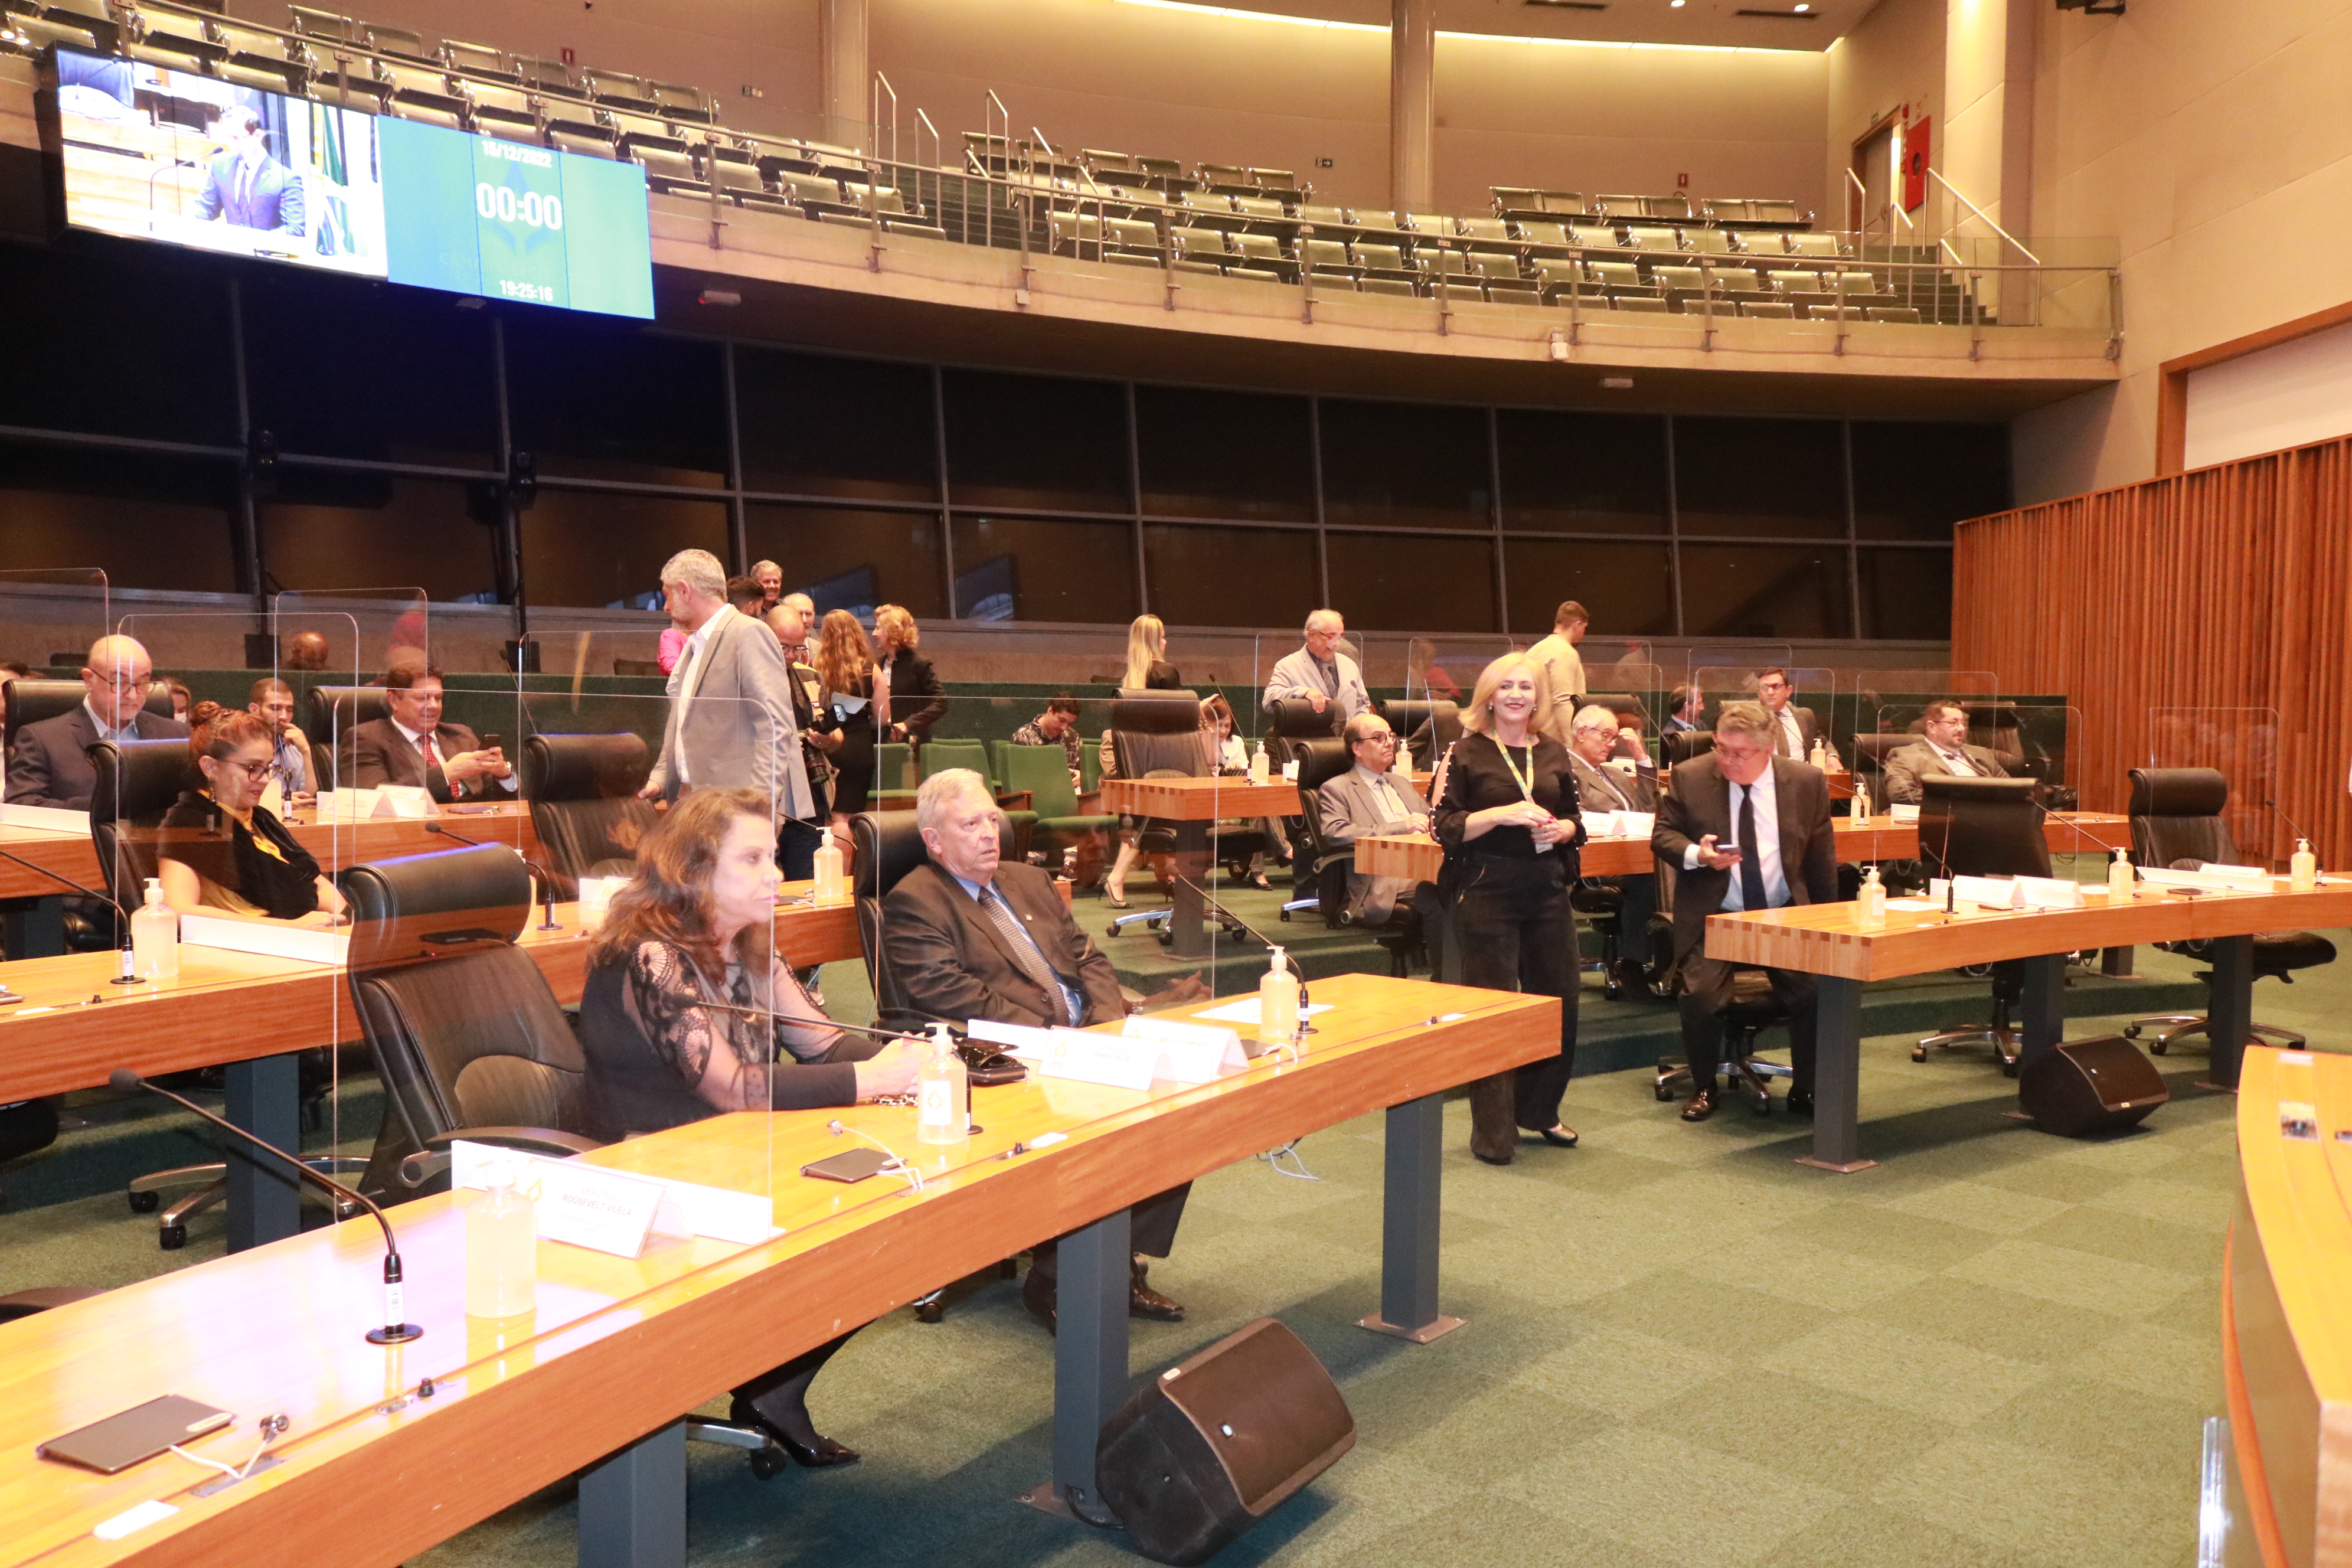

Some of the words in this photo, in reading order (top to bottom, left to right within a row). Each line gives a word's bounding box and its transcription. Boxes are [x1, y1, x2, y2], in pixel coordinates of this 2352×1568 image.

[482, 141, 552, 168] 15/12/2022
[476, 183, 562, 230] 00:00
[499, 280, 553, 302] 19:25:16
[1113, 1054, 1130, 1062] FELIX
[562, 1194, 606, 1210] ROOSEVELT
[607, 1204, 632, 1216] VILELA
[581, 1187, 621, 1202] DEPUTADO
